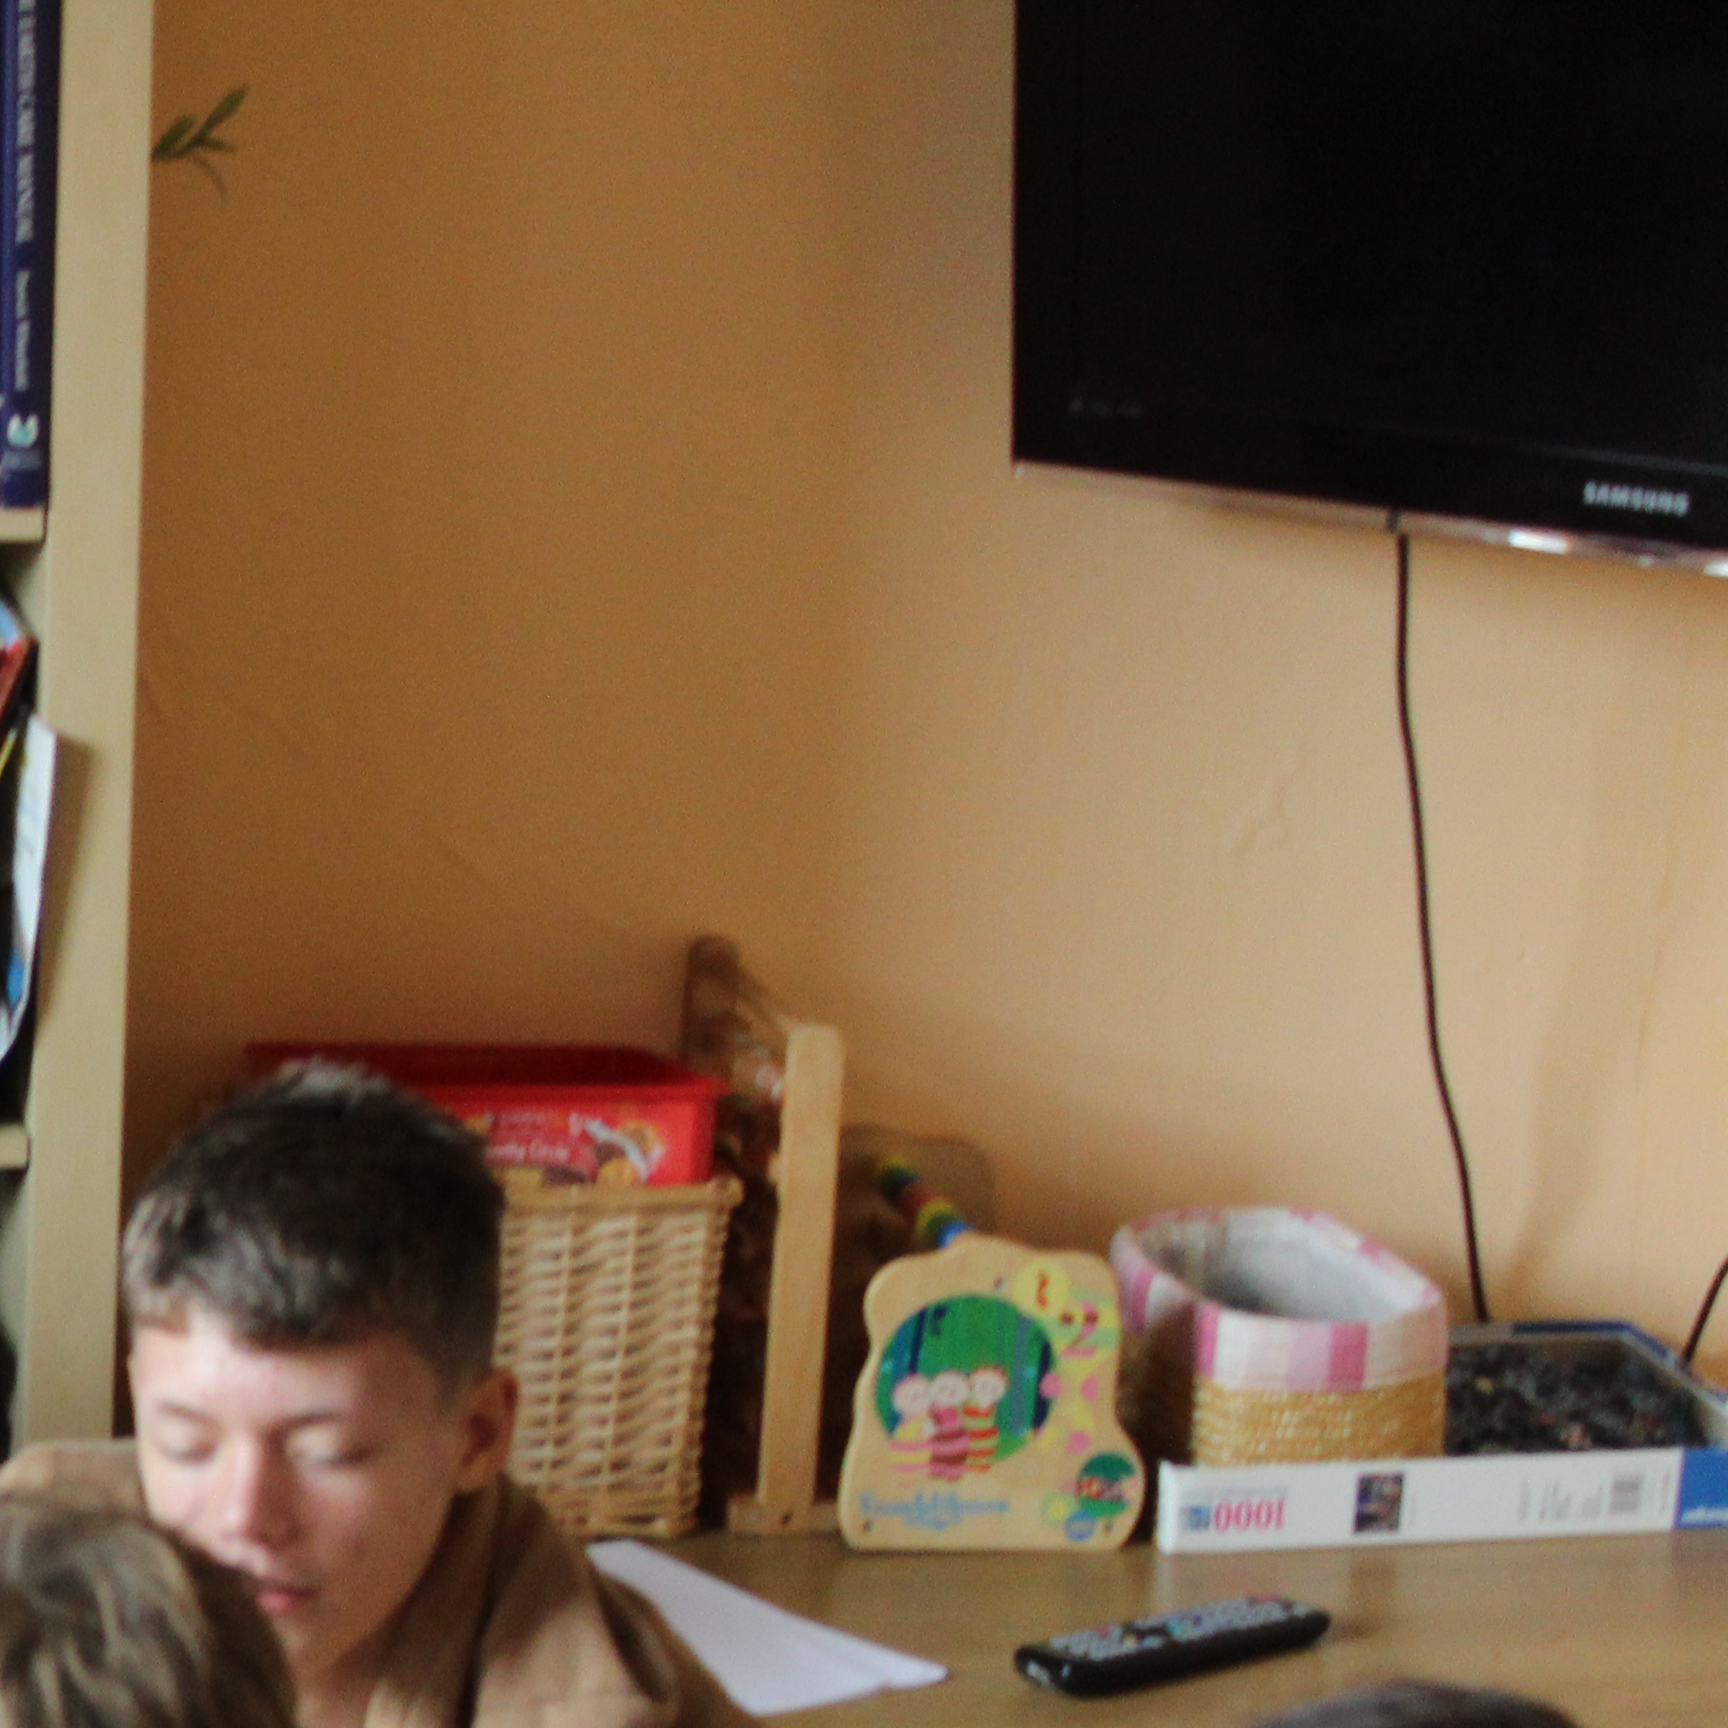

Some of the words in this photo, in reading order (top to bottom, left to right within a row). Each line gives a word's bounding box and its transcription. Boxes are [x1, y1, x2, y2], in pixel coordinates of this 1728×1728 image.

[1581, 480, 1690, 516] SAMSUNG
[1058, 1300, 1100, 1361] 2
[1211, 1495, 1287, 1534] 1000
